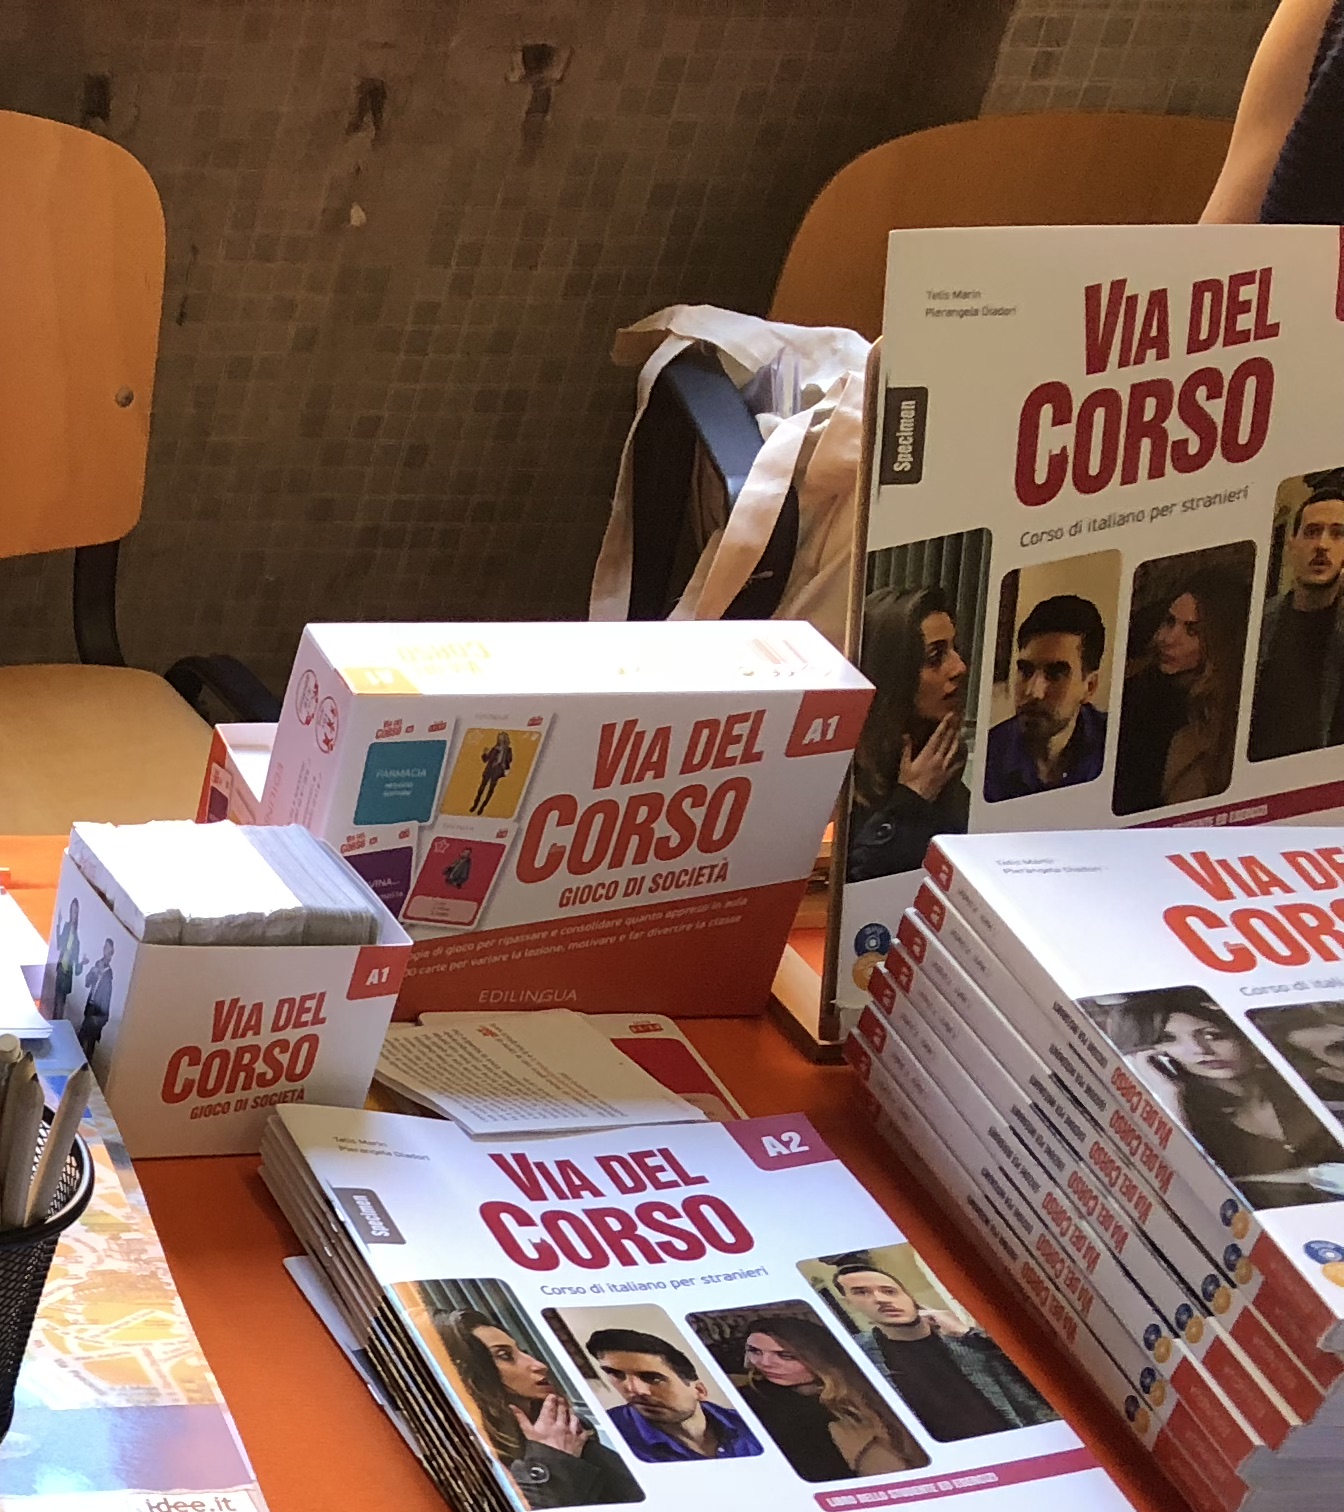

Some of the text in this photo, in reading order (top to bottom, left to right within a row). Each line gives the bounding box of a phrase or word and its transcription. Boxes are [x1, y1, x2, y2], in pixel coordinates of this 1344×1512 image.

[1186, 267, 1280, 355] DEL
[1020, 485, 1249, 548] Corso italiano stranieri
[680, 709, 766, 776] DEL
[801, 716, 840, 746] A1
[559, 859, 728, 908] GIOCO DI SOCIETÀ
[270, 992, 326, 1033] DEL
[478, 989, 577, 1003] EDILINGUA
[763, 1131, 809, 1157] A2
[598, 1147, 709, 1195] DEL
[608, 1265, 768, 1292] italiano stranieri
